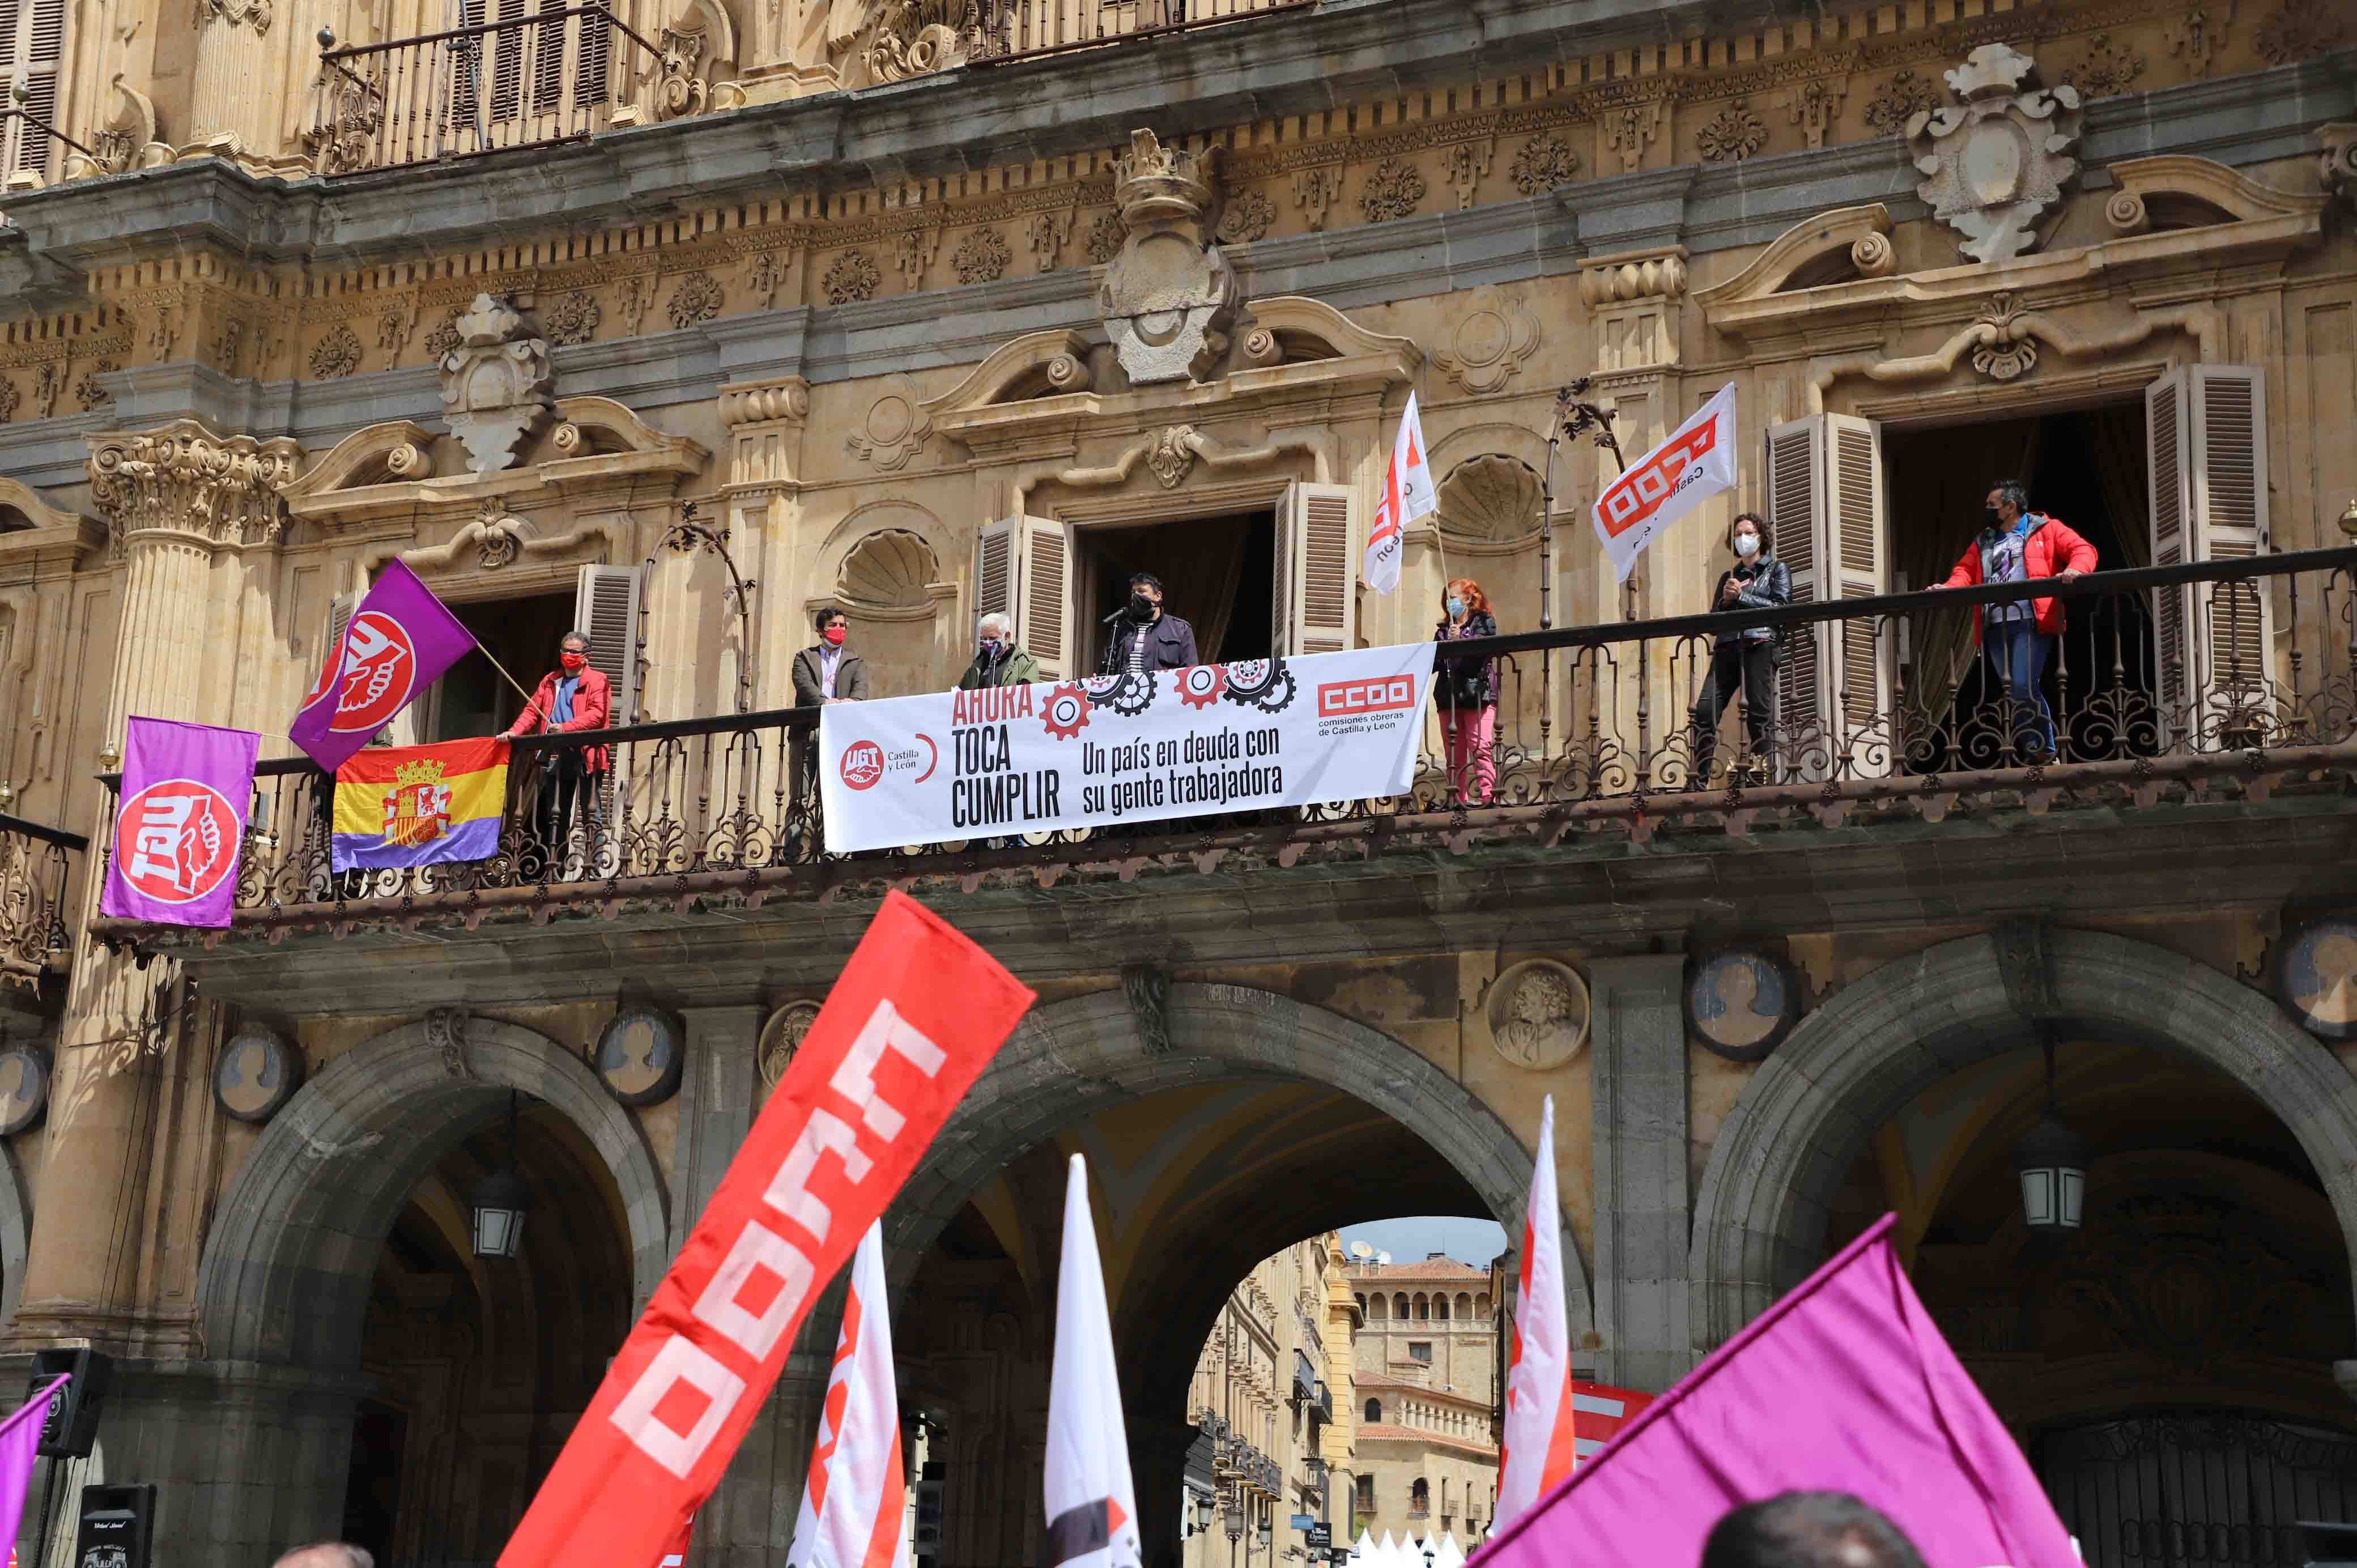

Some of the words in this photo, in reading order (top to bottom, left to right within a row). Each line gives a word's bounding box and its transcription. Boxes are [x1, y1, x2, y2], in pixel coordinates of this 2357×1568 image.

[952, 684, 1033, 726] AHORA
[1325, 681, 1409, 710] CCOO
[1318, 715, 1368, 727] comisiones
[1371, 712, 1404, 721] obreras
[1332, 725, 1364, 735] Castilla
[1374, 722, 1396, 730] León
[888, 749, 919, 761] Castilla
[888, 764, 893, 773] y
[896, 759, 916, 770] León
[952, 725, 1011, 776] TOCA
[1083, 742, 1105, 775] Un
[1112, 736, 1150, 777] país
[1156, 739, 1177, 767] en
[1184, 726, 1240, 764] deuda
[1246, 727, 1279, 757] con
[952, 769, 1060, 828] CUMPLIR
[1083, 785, 1105, 813] su
[1111, 772, 1164, 816] gente
[1169, 761, 1283, 805] trabajadora
[609, 998, 948, 1480] CCOO
